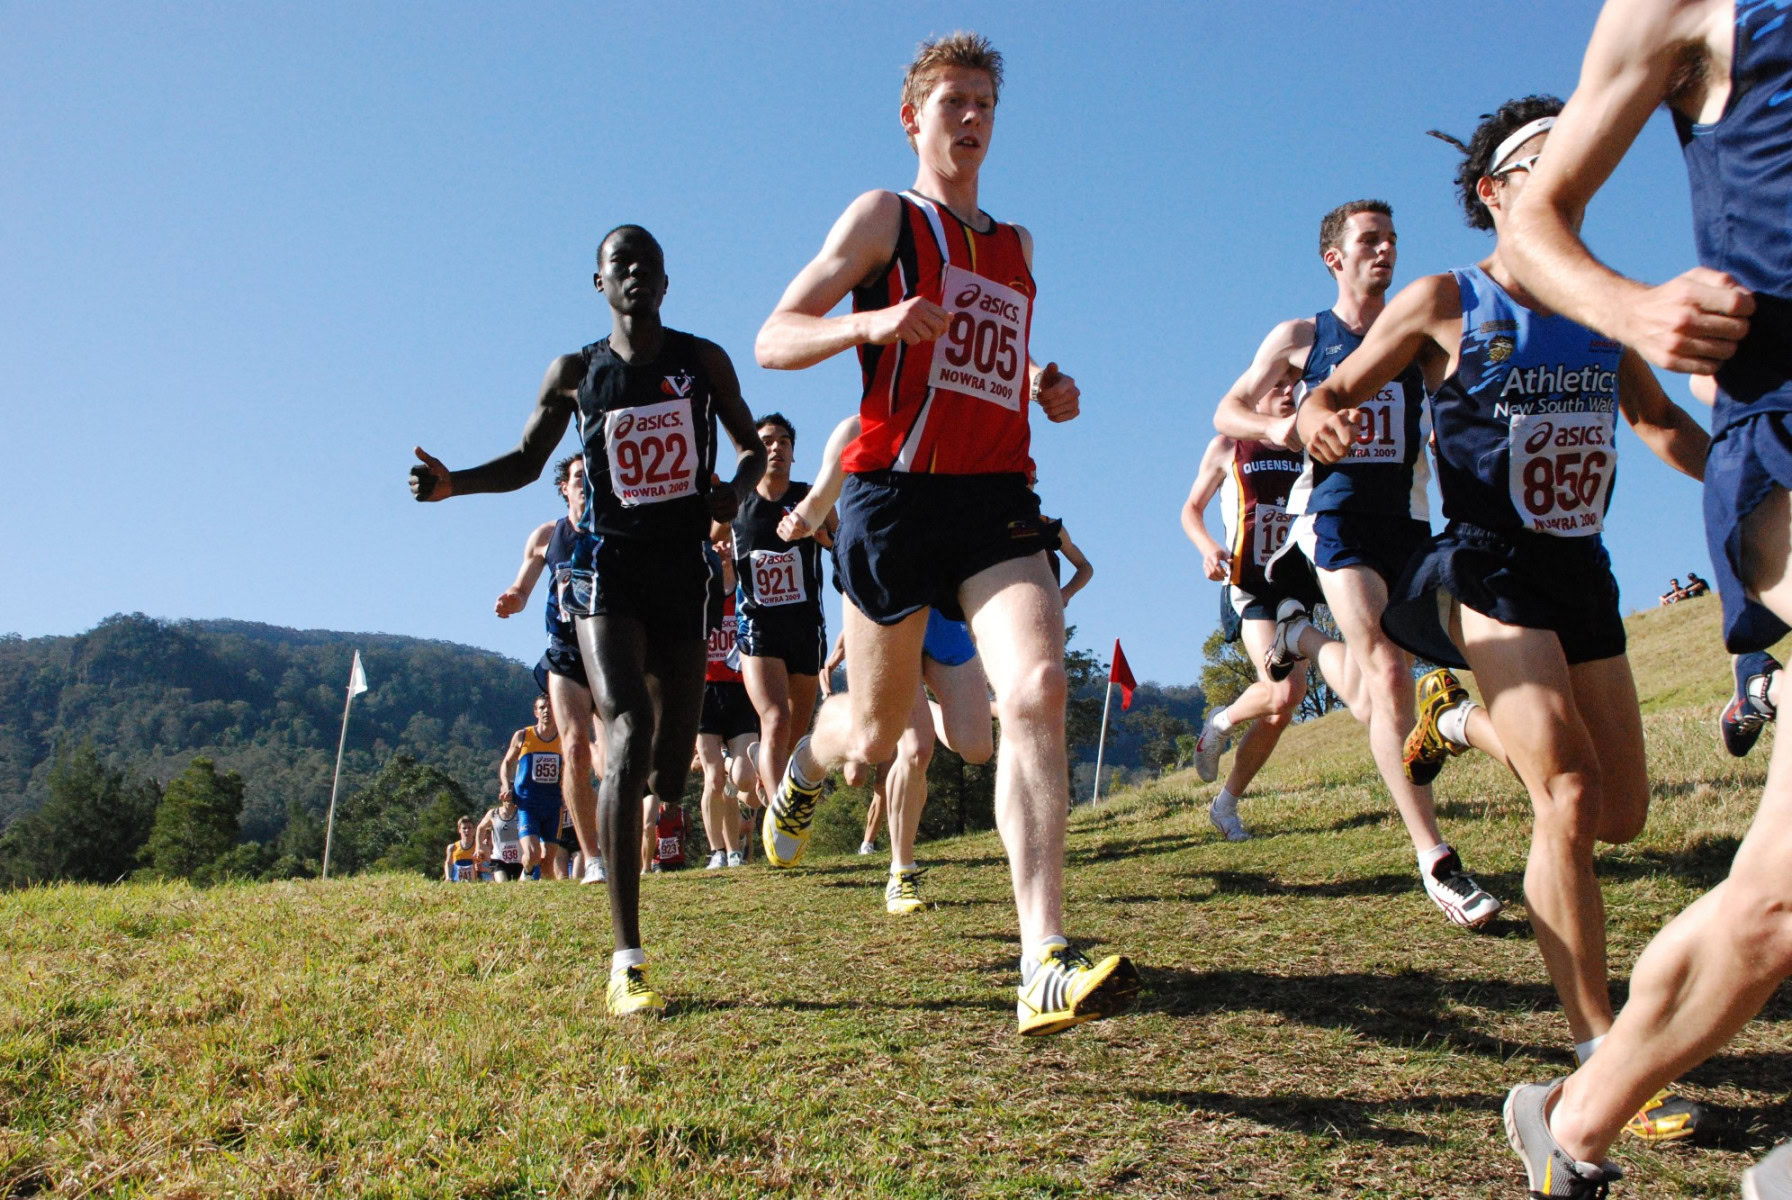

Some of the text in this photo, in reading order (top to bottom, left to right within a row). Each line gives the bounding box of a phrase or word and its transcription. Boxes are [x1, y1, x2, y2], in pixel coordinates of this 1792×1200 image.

[945, 311, 1018, 382] 905
[939, 367, 1013, 400] NOWRA 2009
[1493, 396, 1615, 418] New South Wale
[1356, 405, 1395, 446] 91
[616, 432, 692, 487] 922
[1348, 448, 1397, 458] WRA 2009
[1243, 459, 1305, 475] QUEENSLA
[623, 481, 690, 498] NOWRA 2009
[1523, 450, 1608, 516] 856
[1580, 512, 1599, 527] 200
[1261, 524, 1289, 555] 19
[757, 565, 798, 596] 921
[760, 593, 801, 604] NOWRA 2009
[535, 763, 557, 778] 853
[502, 848, 518, 861] 938
[662, 843, 677, 855] 923
